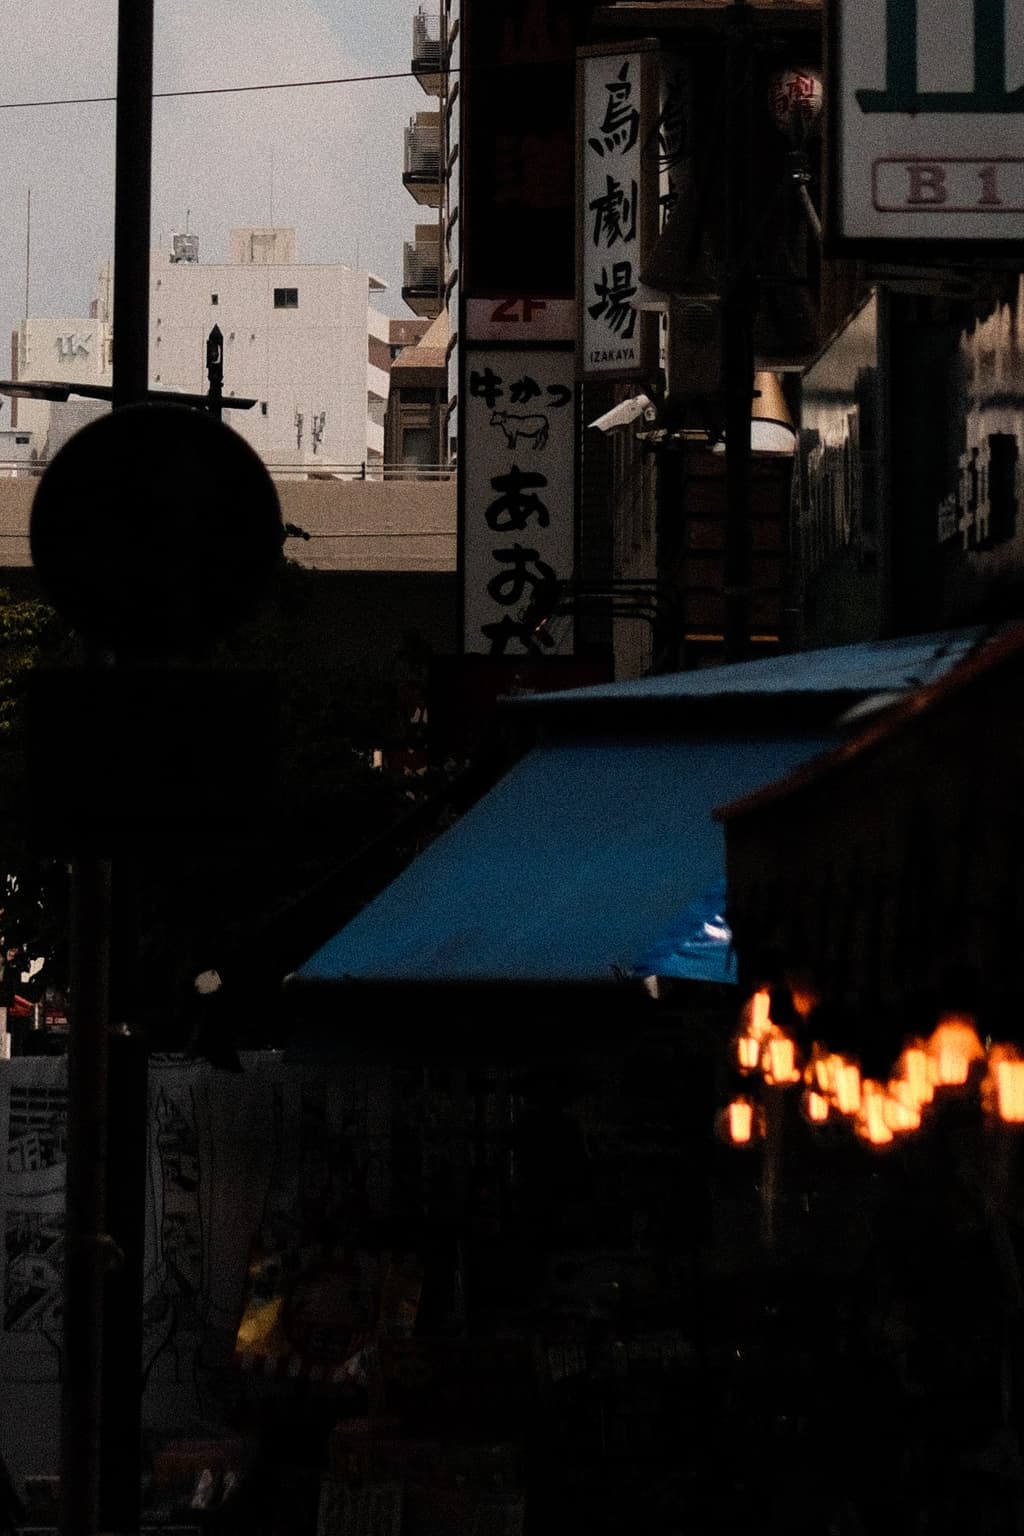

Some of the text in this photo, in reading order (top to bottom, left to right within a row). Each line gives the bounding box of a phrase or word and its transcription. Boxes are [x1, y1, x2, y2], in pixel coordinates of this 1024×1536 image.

[490, 296, 546, 323] 2F
[590, 347, 635, 363] IZAKAYA
[470, 367, 573, 409] 牛かつ
